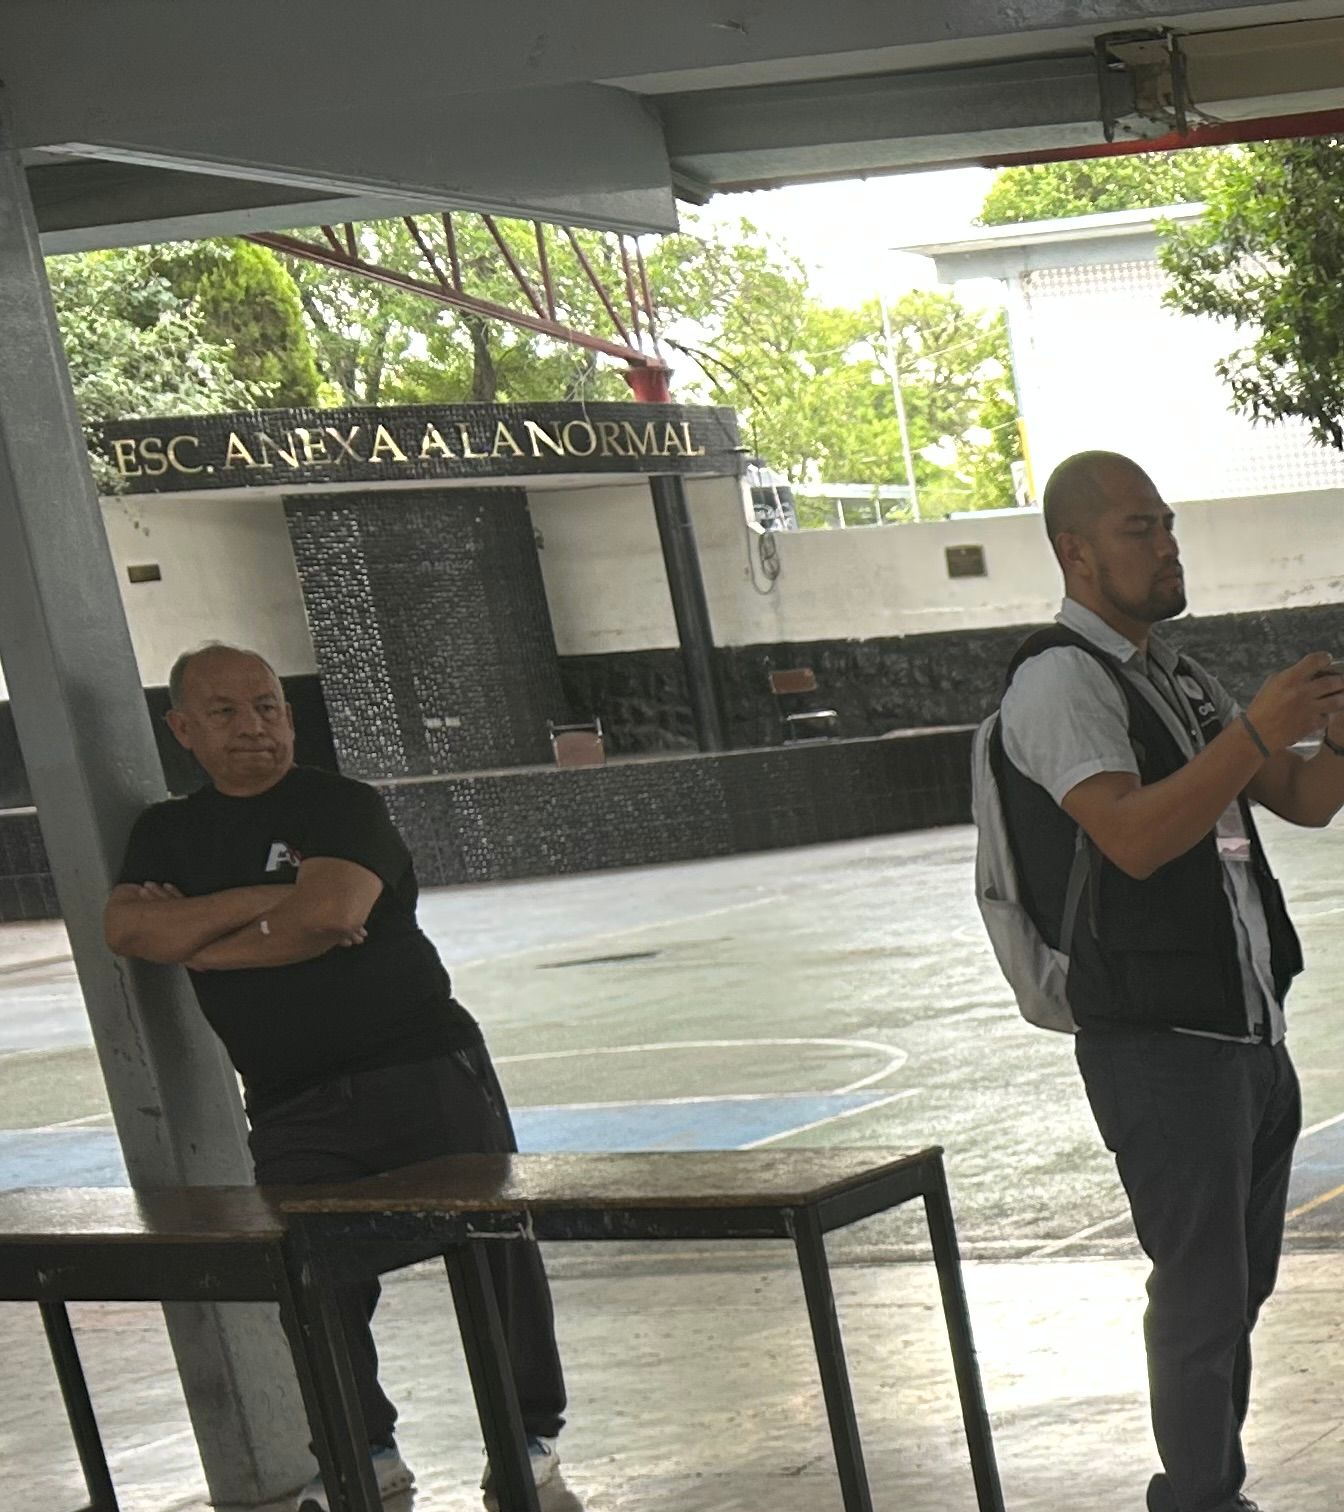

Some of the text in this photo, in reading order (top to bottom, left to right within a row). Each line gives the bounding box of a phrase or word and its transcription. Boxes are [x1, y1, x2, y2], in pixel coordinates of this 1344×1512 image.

[112, 435, 214, 476] ESC.
[222, 424, 407, 469] ANEXA
[523, 420, 705, 458] NORMAL
